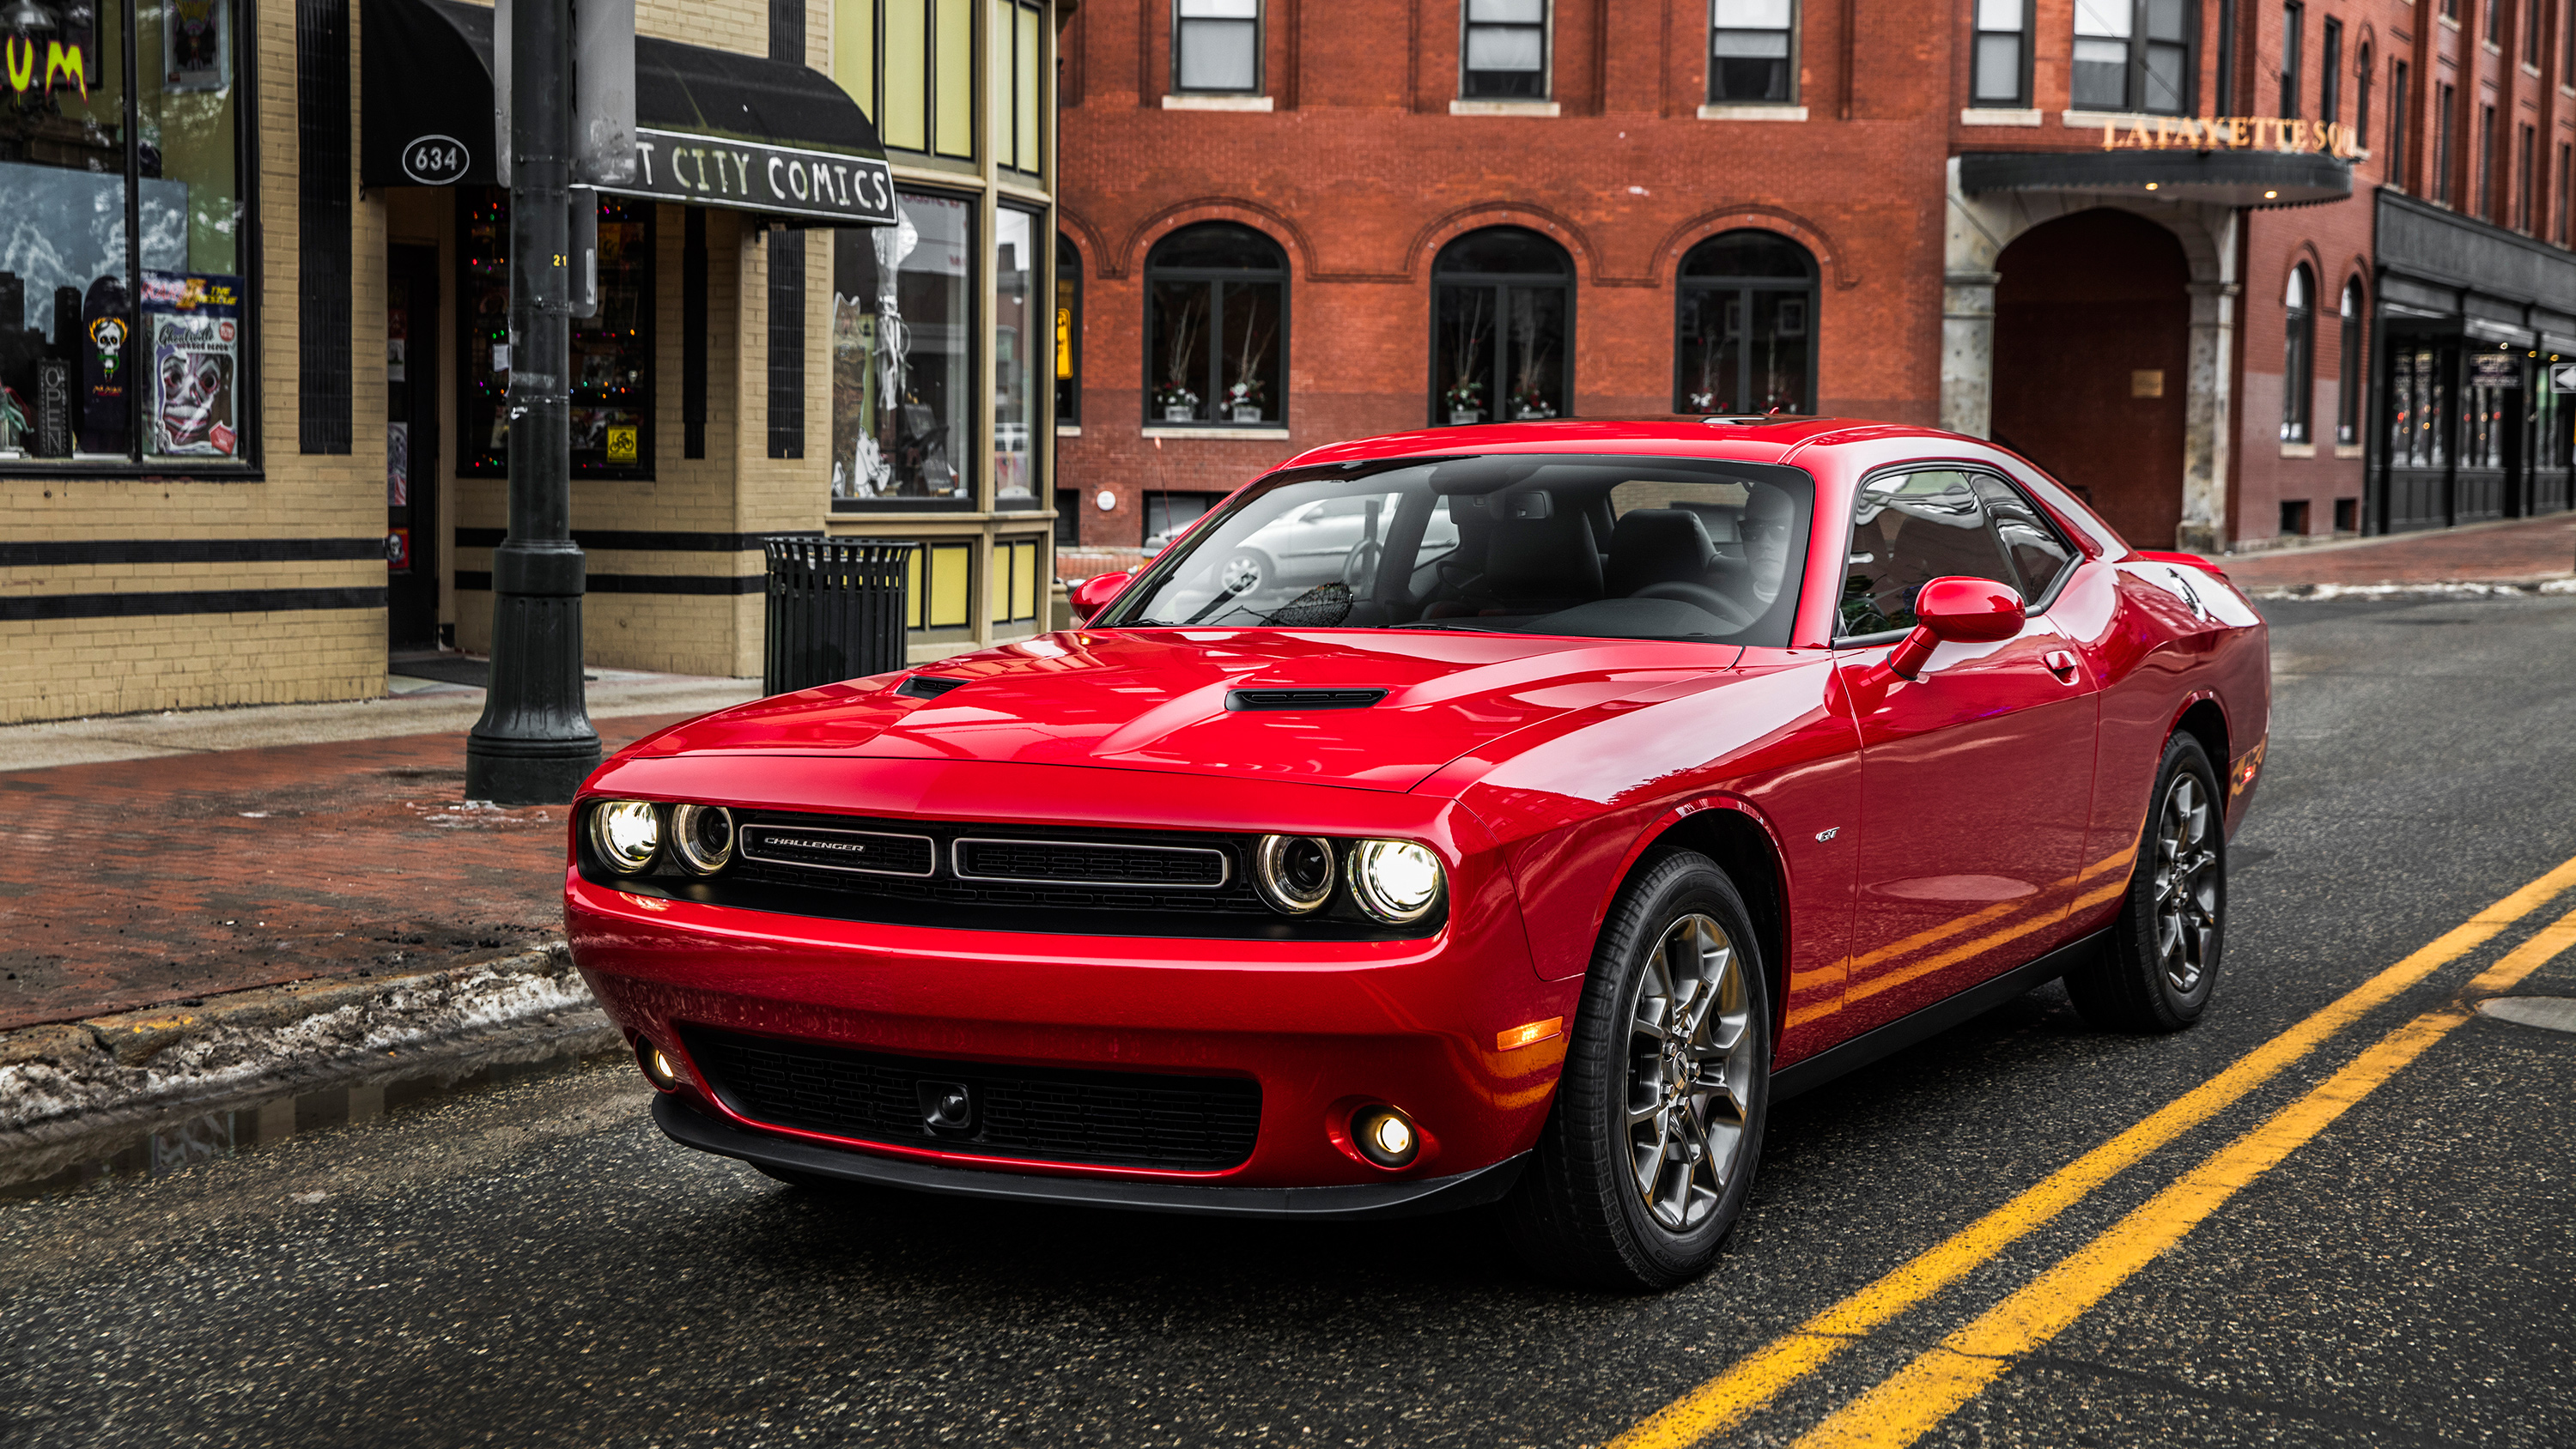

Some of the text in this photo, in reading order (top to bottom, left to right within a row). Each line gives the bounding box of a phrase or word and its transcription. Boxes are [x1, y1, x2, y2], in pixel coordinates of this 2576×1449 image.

[2102, 116, 2311, 149] LAFAYETTE
[415, 146, 458, 171] 634
[672, 147, 750, 196] CITY
[768, 156, 888, 211] COMICS
[552, 254, 568, 268] 21
[45, 367, 62, 455] OPEN
[764, 837, 866, 852] CHALLENGER
[1815, 827, 1840, 842] GT
